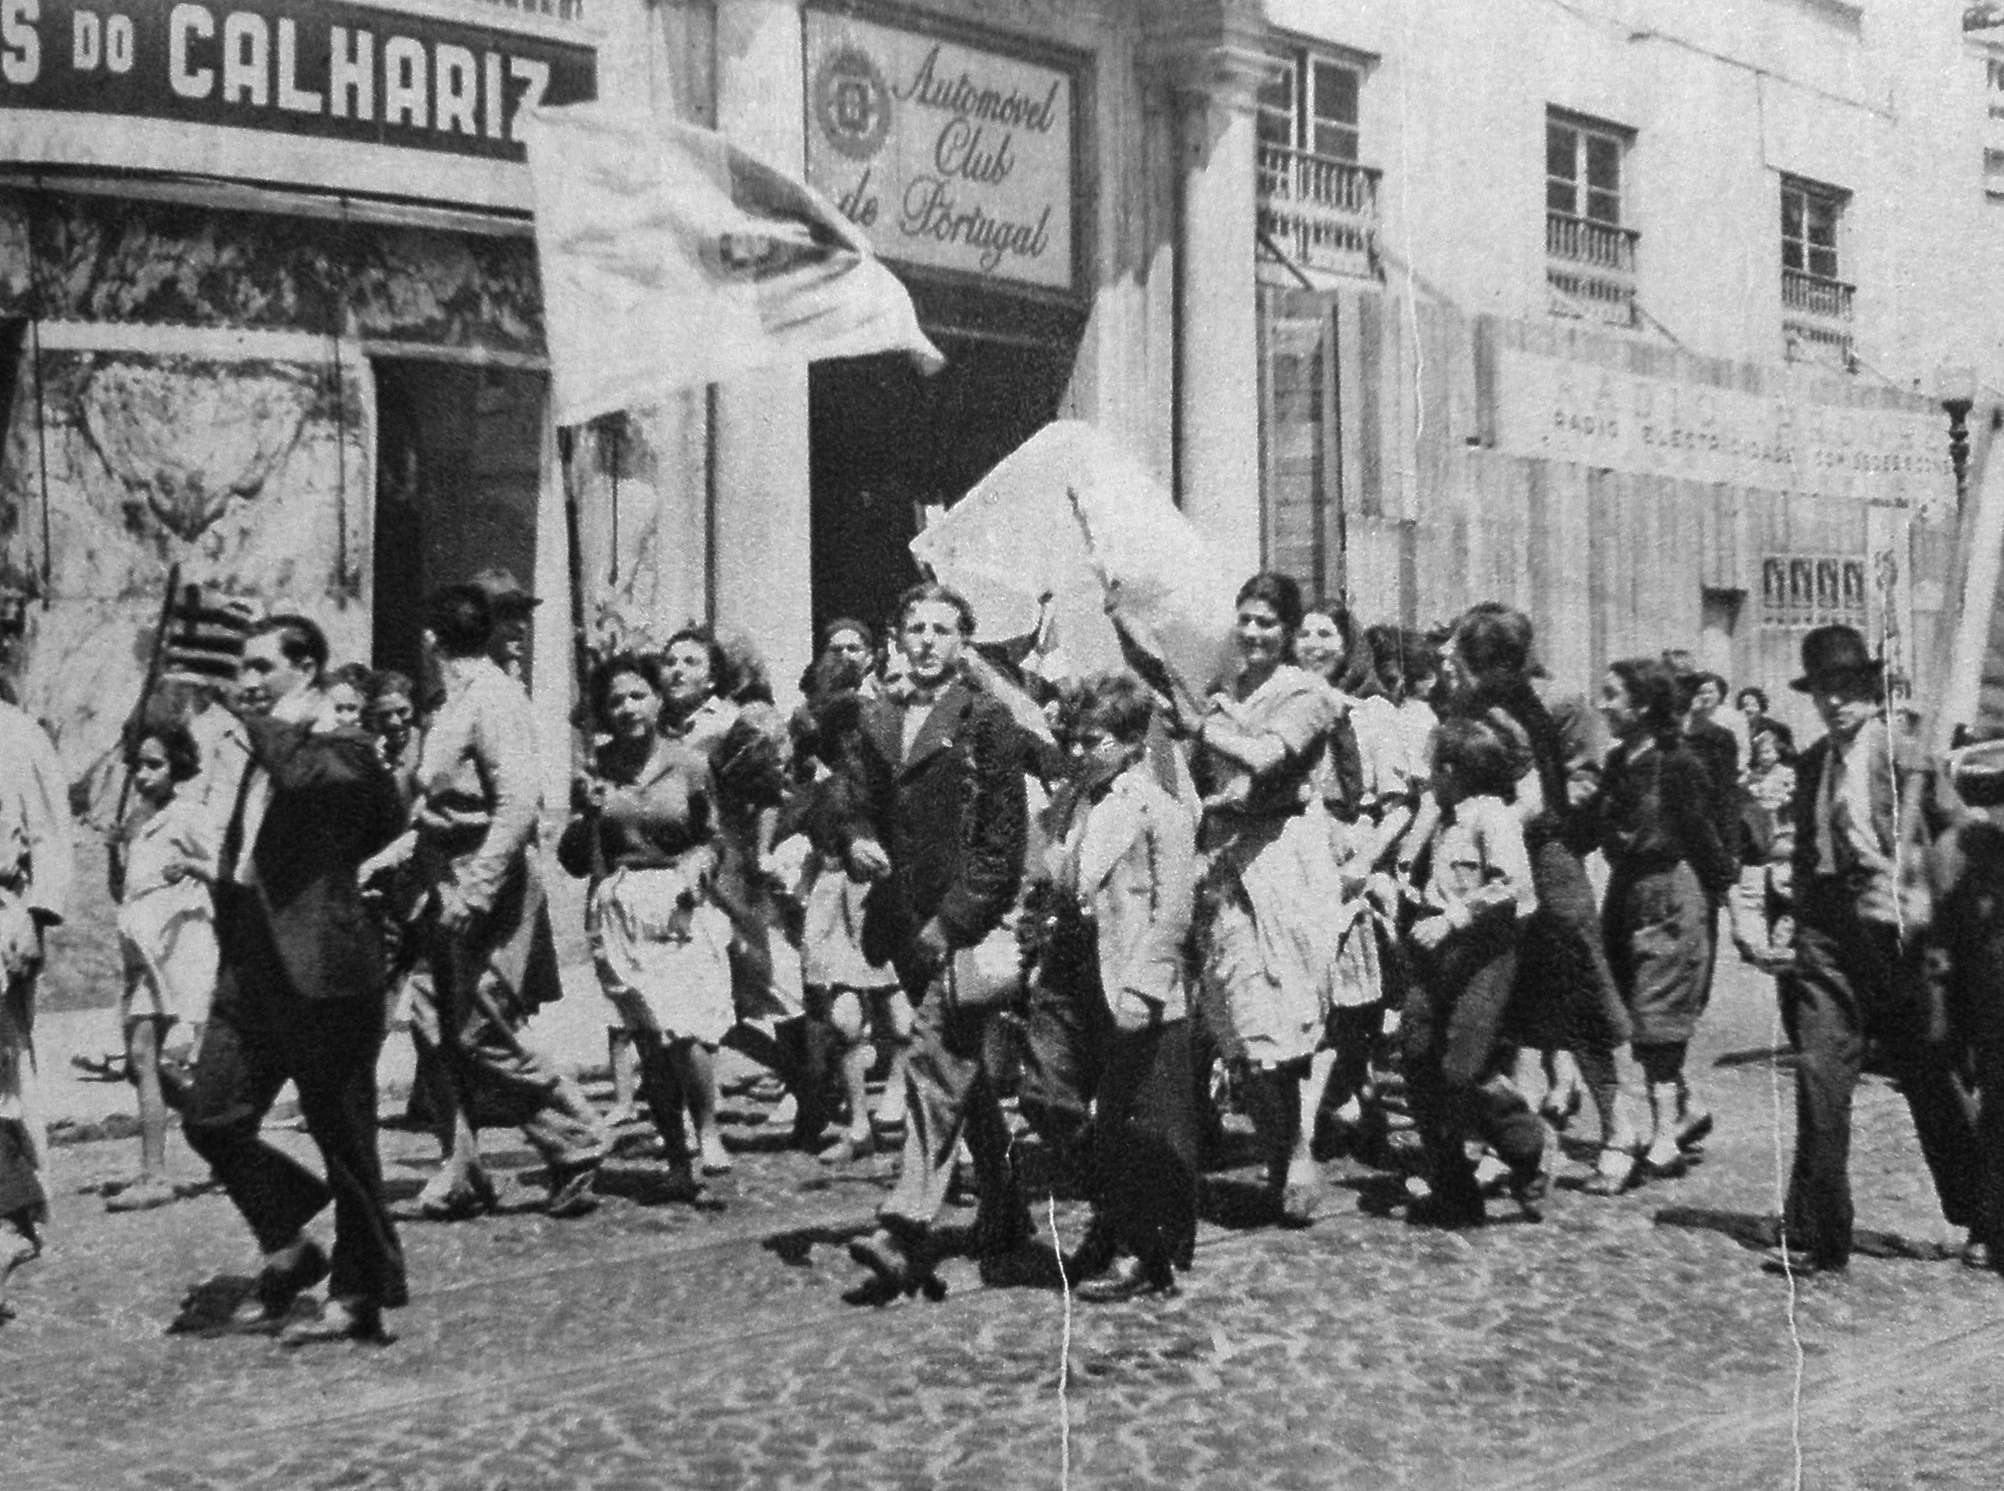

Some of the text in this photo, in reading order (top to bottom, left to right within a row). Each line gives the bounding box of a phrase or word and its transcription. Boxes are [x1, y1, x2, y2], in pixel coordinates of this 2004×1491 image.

[72, 9, 133, 73] DO
[169, 2, 550, 143] CALHARIZ
[934, 116, 1015, 186] Club
[837, 167, 1051, 272] de Portugal
